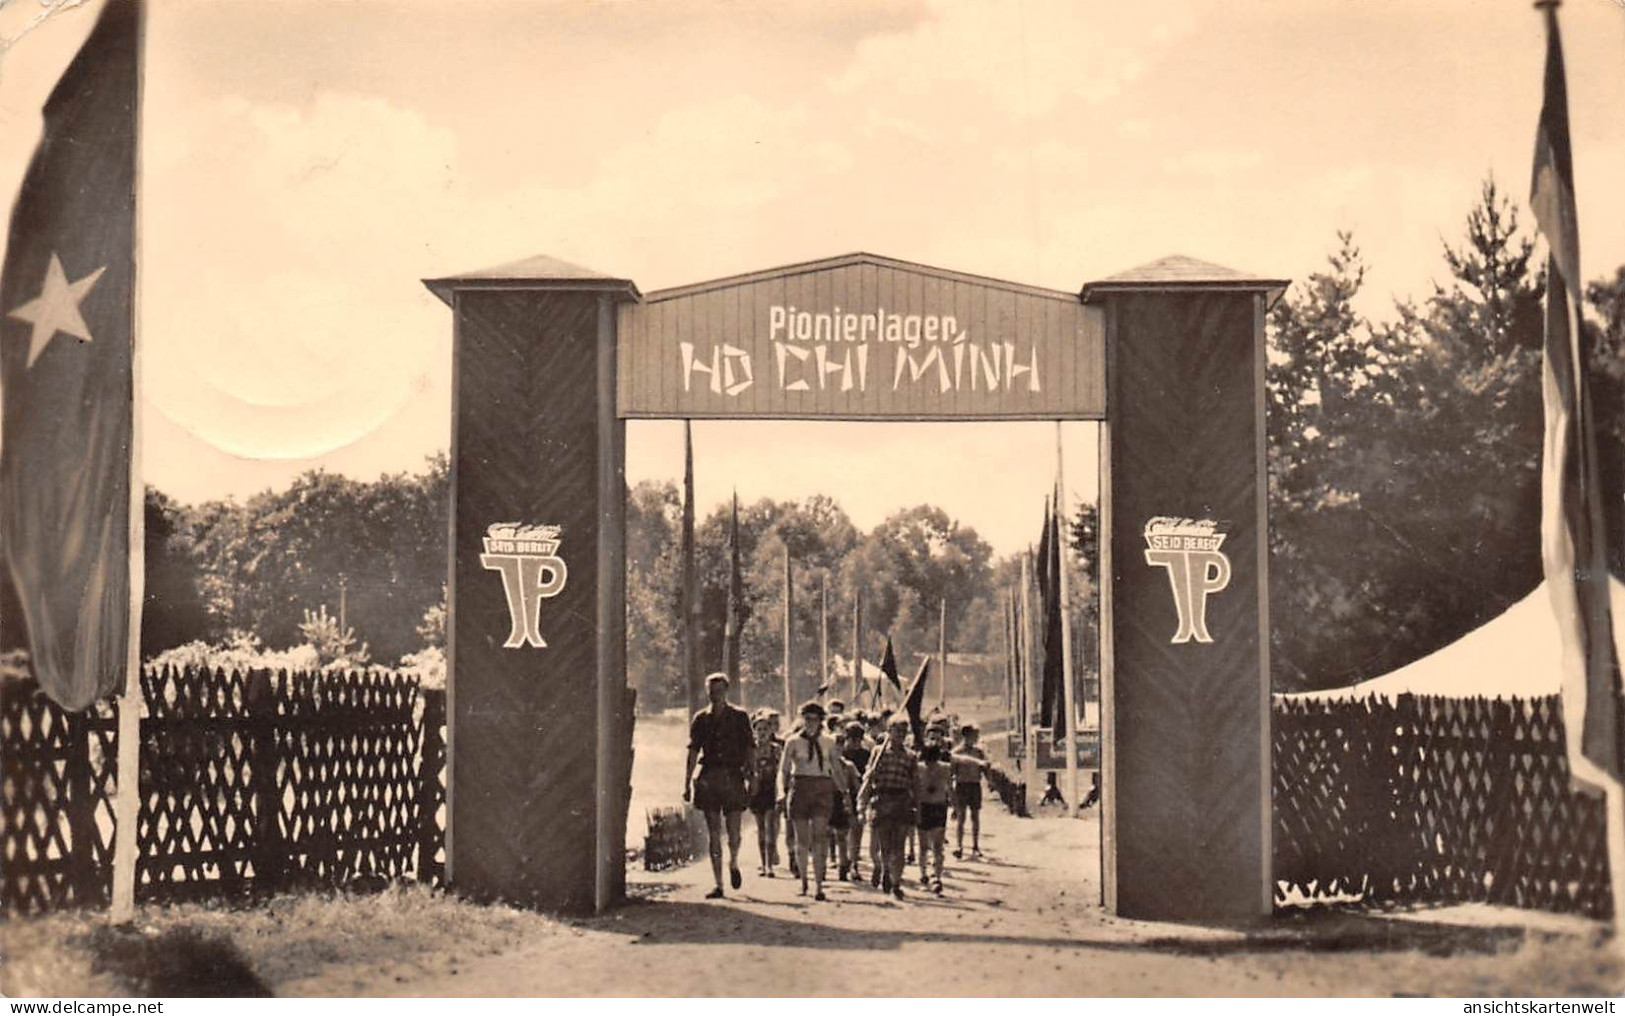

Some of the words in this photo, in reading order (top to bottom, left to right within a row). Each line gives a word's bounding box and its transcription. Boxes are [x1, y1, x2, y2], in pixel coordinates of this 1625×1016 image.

[769, 306, 957, 348] Pionierlager
[680, 342, 754, 396] HO
[775, 341, 868, 393] CHI
[1153, 536, 1181, 549] SEID
